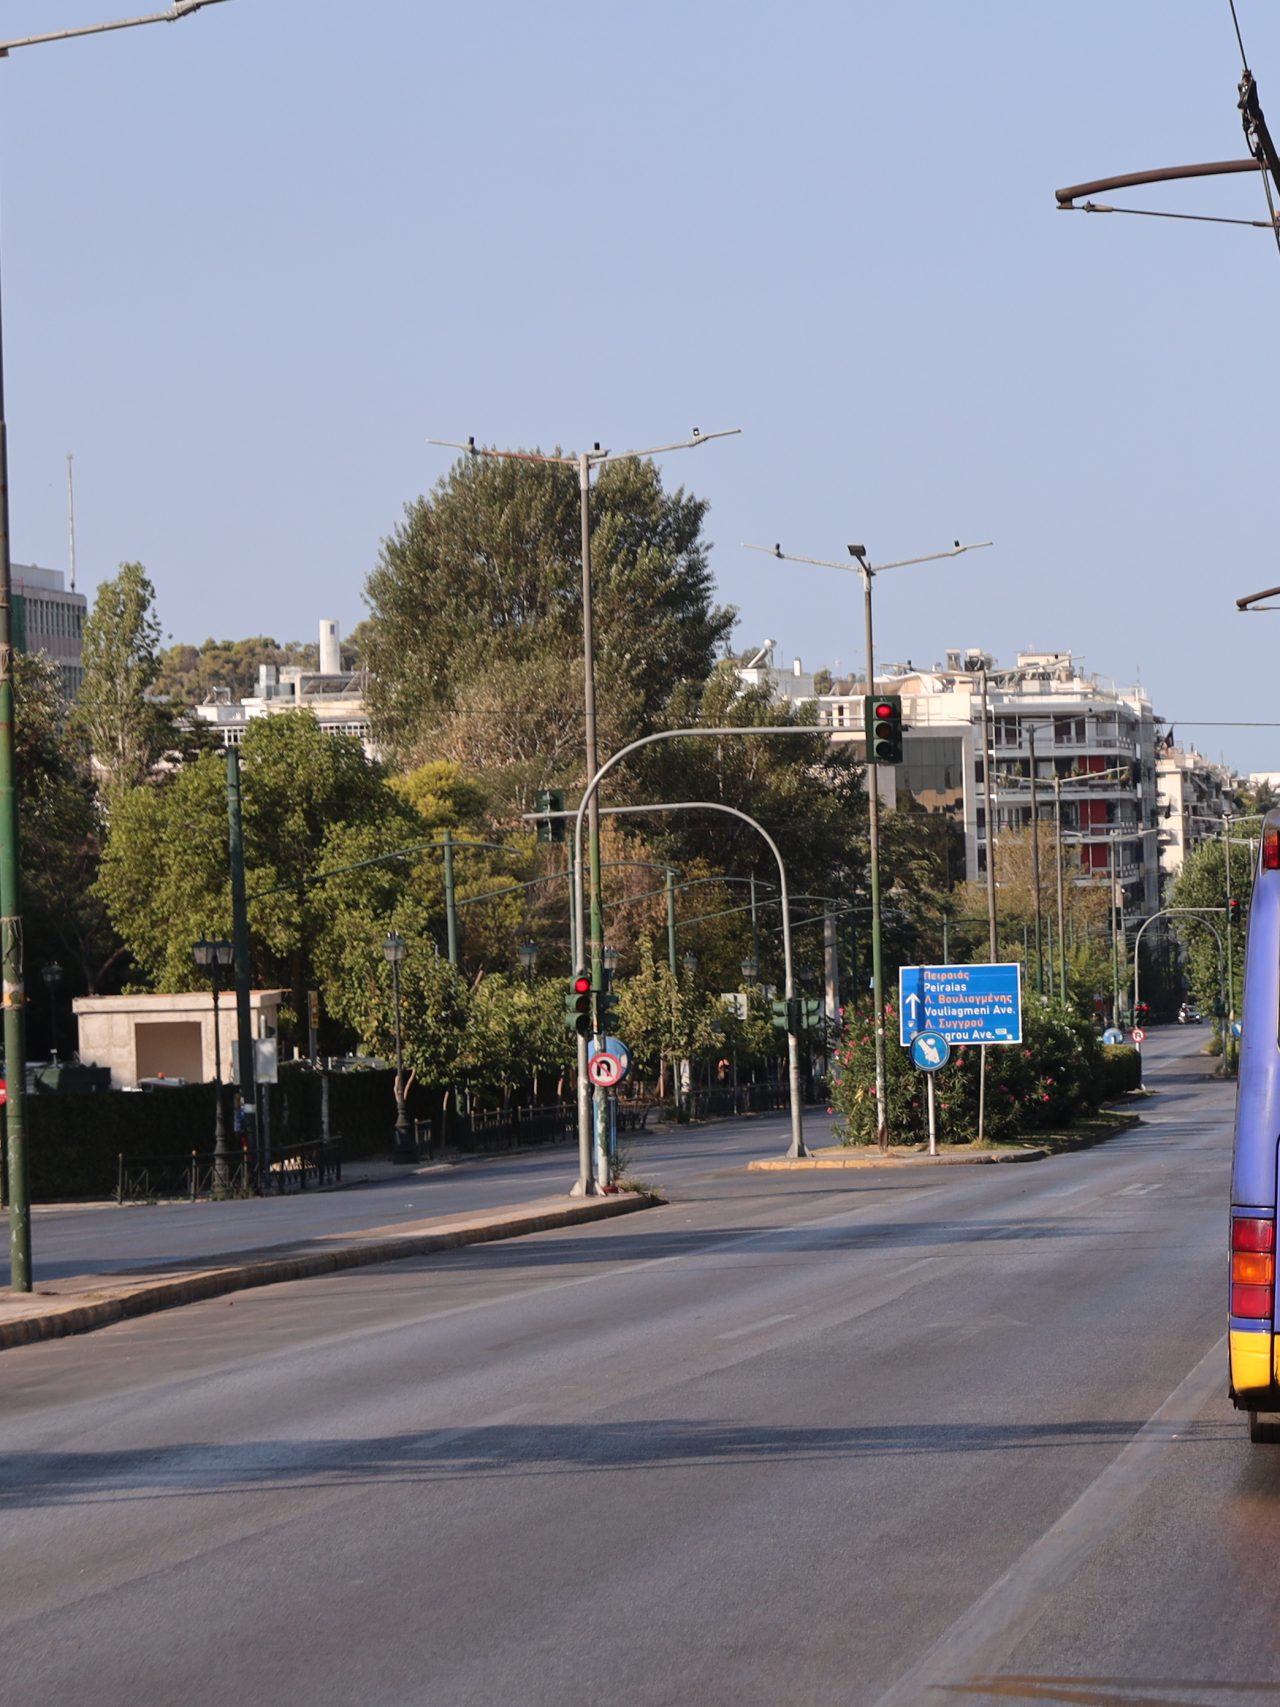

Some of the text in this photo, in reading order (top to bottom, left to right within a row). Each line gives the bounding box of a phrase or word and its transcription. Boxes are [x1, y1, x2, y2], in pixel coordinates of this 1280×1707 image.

[923, 970, 970, 981] Πειραιάς
[924, 983, 967, 992] Peiraias
[924, 993, 1012, 1005] Λ. Βουλιαγμένης
[924, 1005, 1016, 1017] Vouliagmeni Ave.
[924, 1018, 984, 1029] Λ. Συγγρού
[972, 1029, 995, 1040] Ave.
